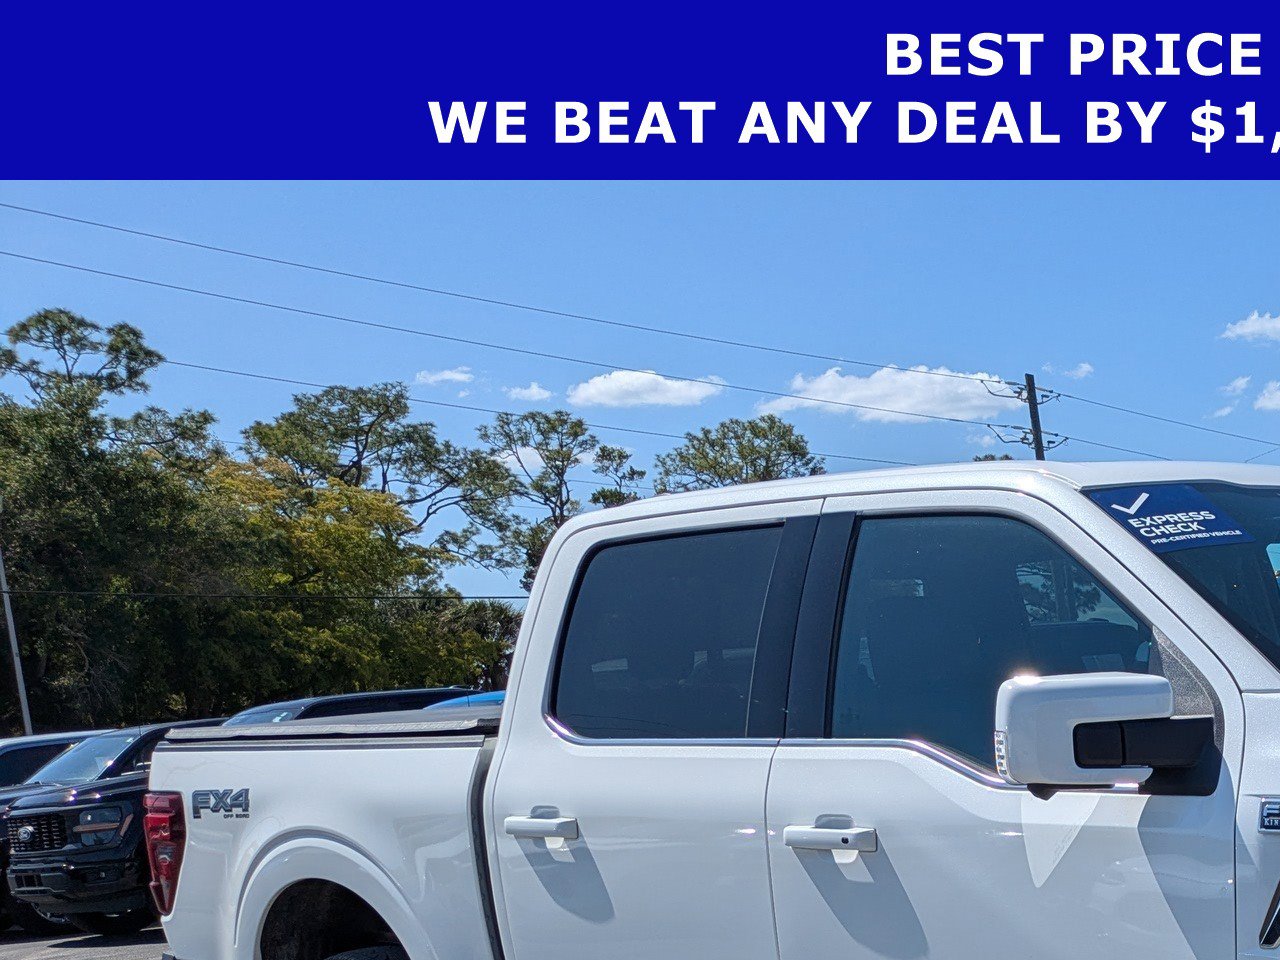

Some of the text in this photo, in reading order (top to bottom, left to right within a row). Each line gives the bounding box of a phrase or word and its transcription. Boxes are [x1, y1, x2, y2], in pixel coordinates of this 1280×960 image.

[1128, 511, 1216, 528] EXPRESS
[1139, 522, 1206, 537] CHECK
[1151, 529, 1242, 545] PRE-CERTIFIED VEHICLE
[192, 788, 250, 819] FX4
